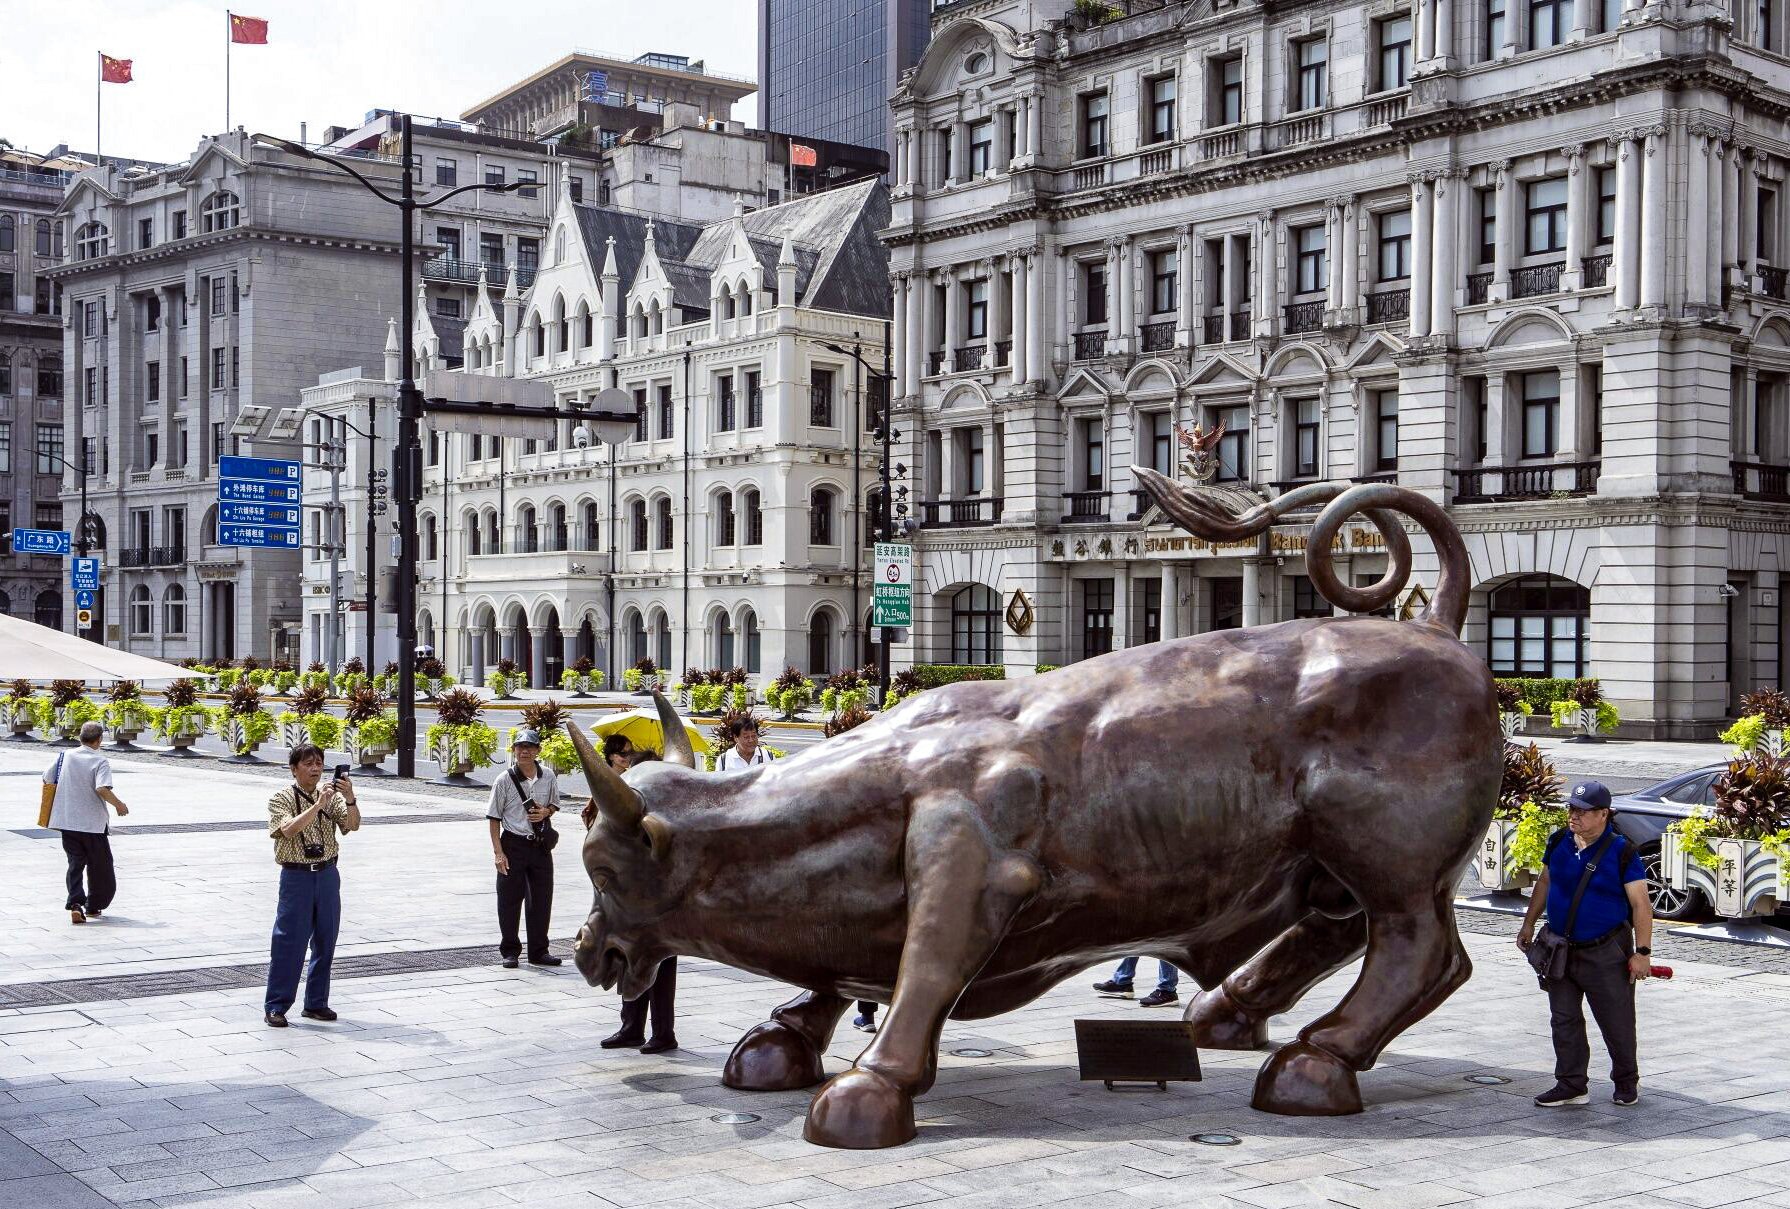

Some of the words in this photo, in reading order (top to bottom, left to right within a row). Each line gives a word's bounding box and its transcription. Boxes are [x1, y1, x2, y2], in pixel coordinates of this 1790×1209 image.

[233, 484, 265, 494] 外滩停车库
[233, 506, 265, 516] 十六铺停车库
[28, 535, 54, 544] 广东路
[1352, 528, 1386, 546] Ban
[877, 546, 910, 557] 延安高架路
[876, 586, 910, 597] 虹桥枢纽方向
[885, 608, 896, 616] 入口
[1485, 838, 1497, 870] 自由
[1721, 859, 1737, 897] 平等
